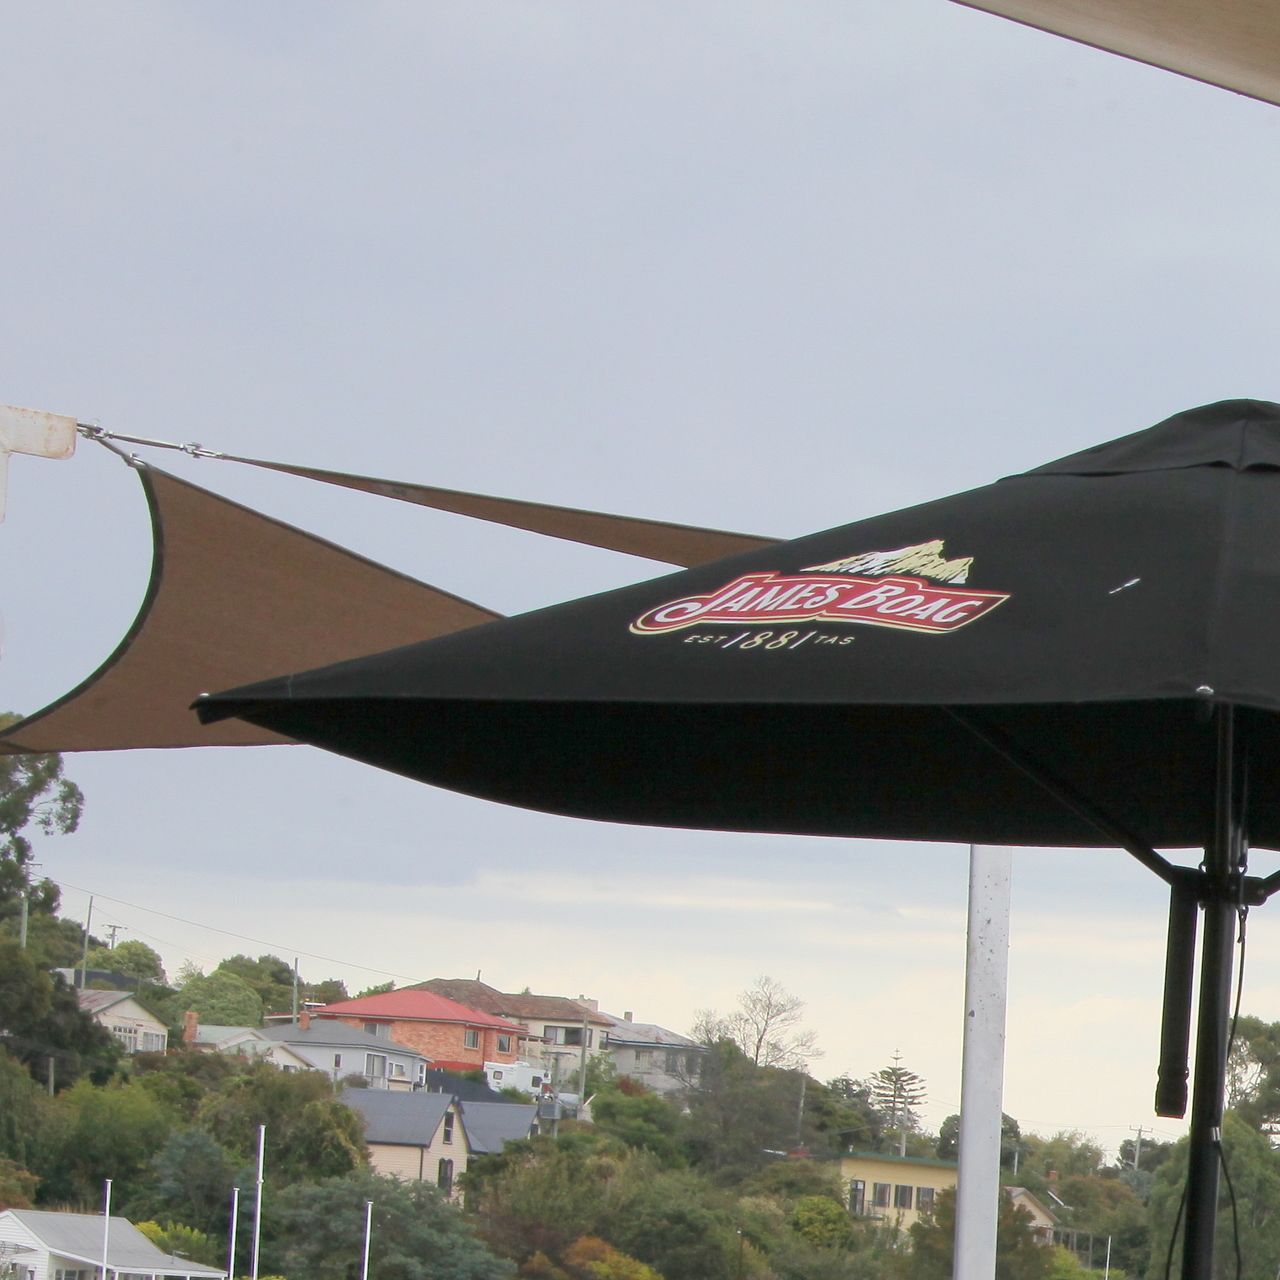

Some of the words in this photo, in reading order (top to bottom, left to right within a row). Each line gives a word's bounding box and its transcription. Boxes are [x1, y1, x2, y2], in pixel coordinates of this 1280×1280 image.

[654, 582, 848, 624] JAMES
[838, 583, 985, 623] BOAG
[683, 635, 725, 644] EST
[722, 630, 816, 649] 1881
[813, 634, 856, 645] TAS
